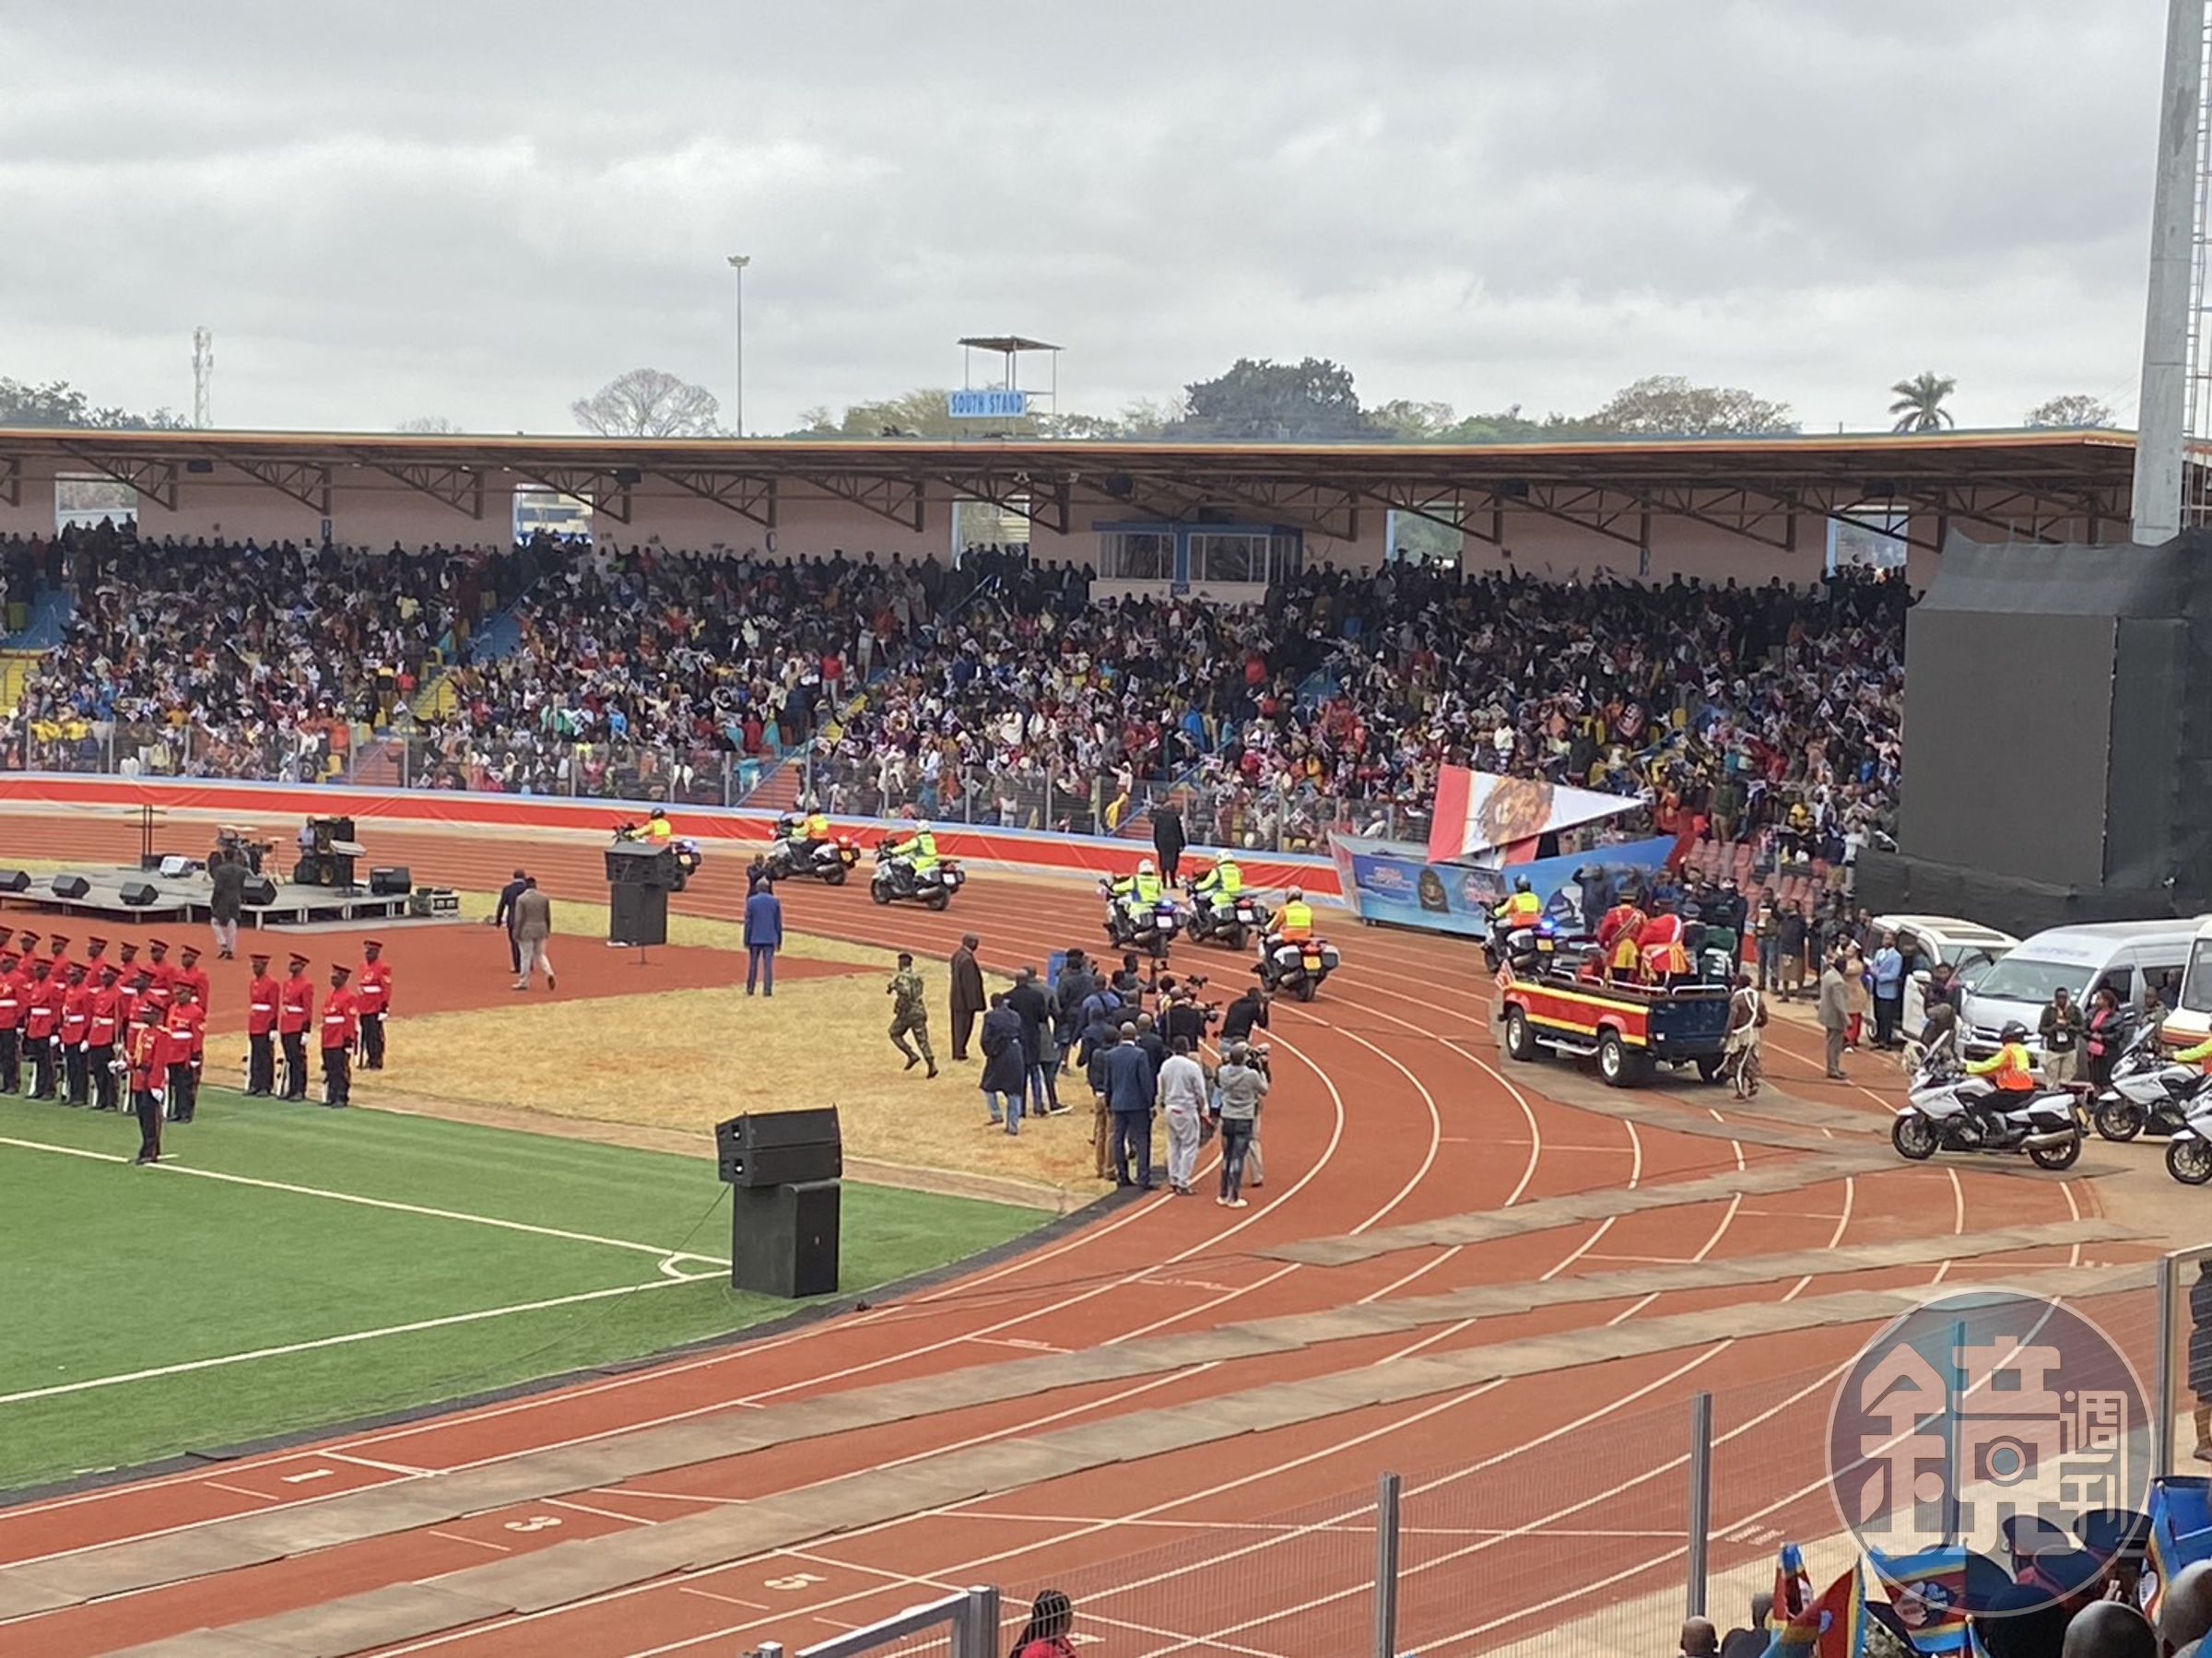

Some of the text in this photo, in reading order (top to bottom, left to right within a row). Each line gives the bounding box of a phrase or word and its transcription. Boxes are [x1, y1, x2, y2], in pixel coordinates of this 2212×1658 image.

[951, 394, 1023, 414] SOUTH STAND
[279, 1468, 335, 1484] 1
[503, 1515, 563, 1532] 3
[763, 1572, 828, 1591] 5
